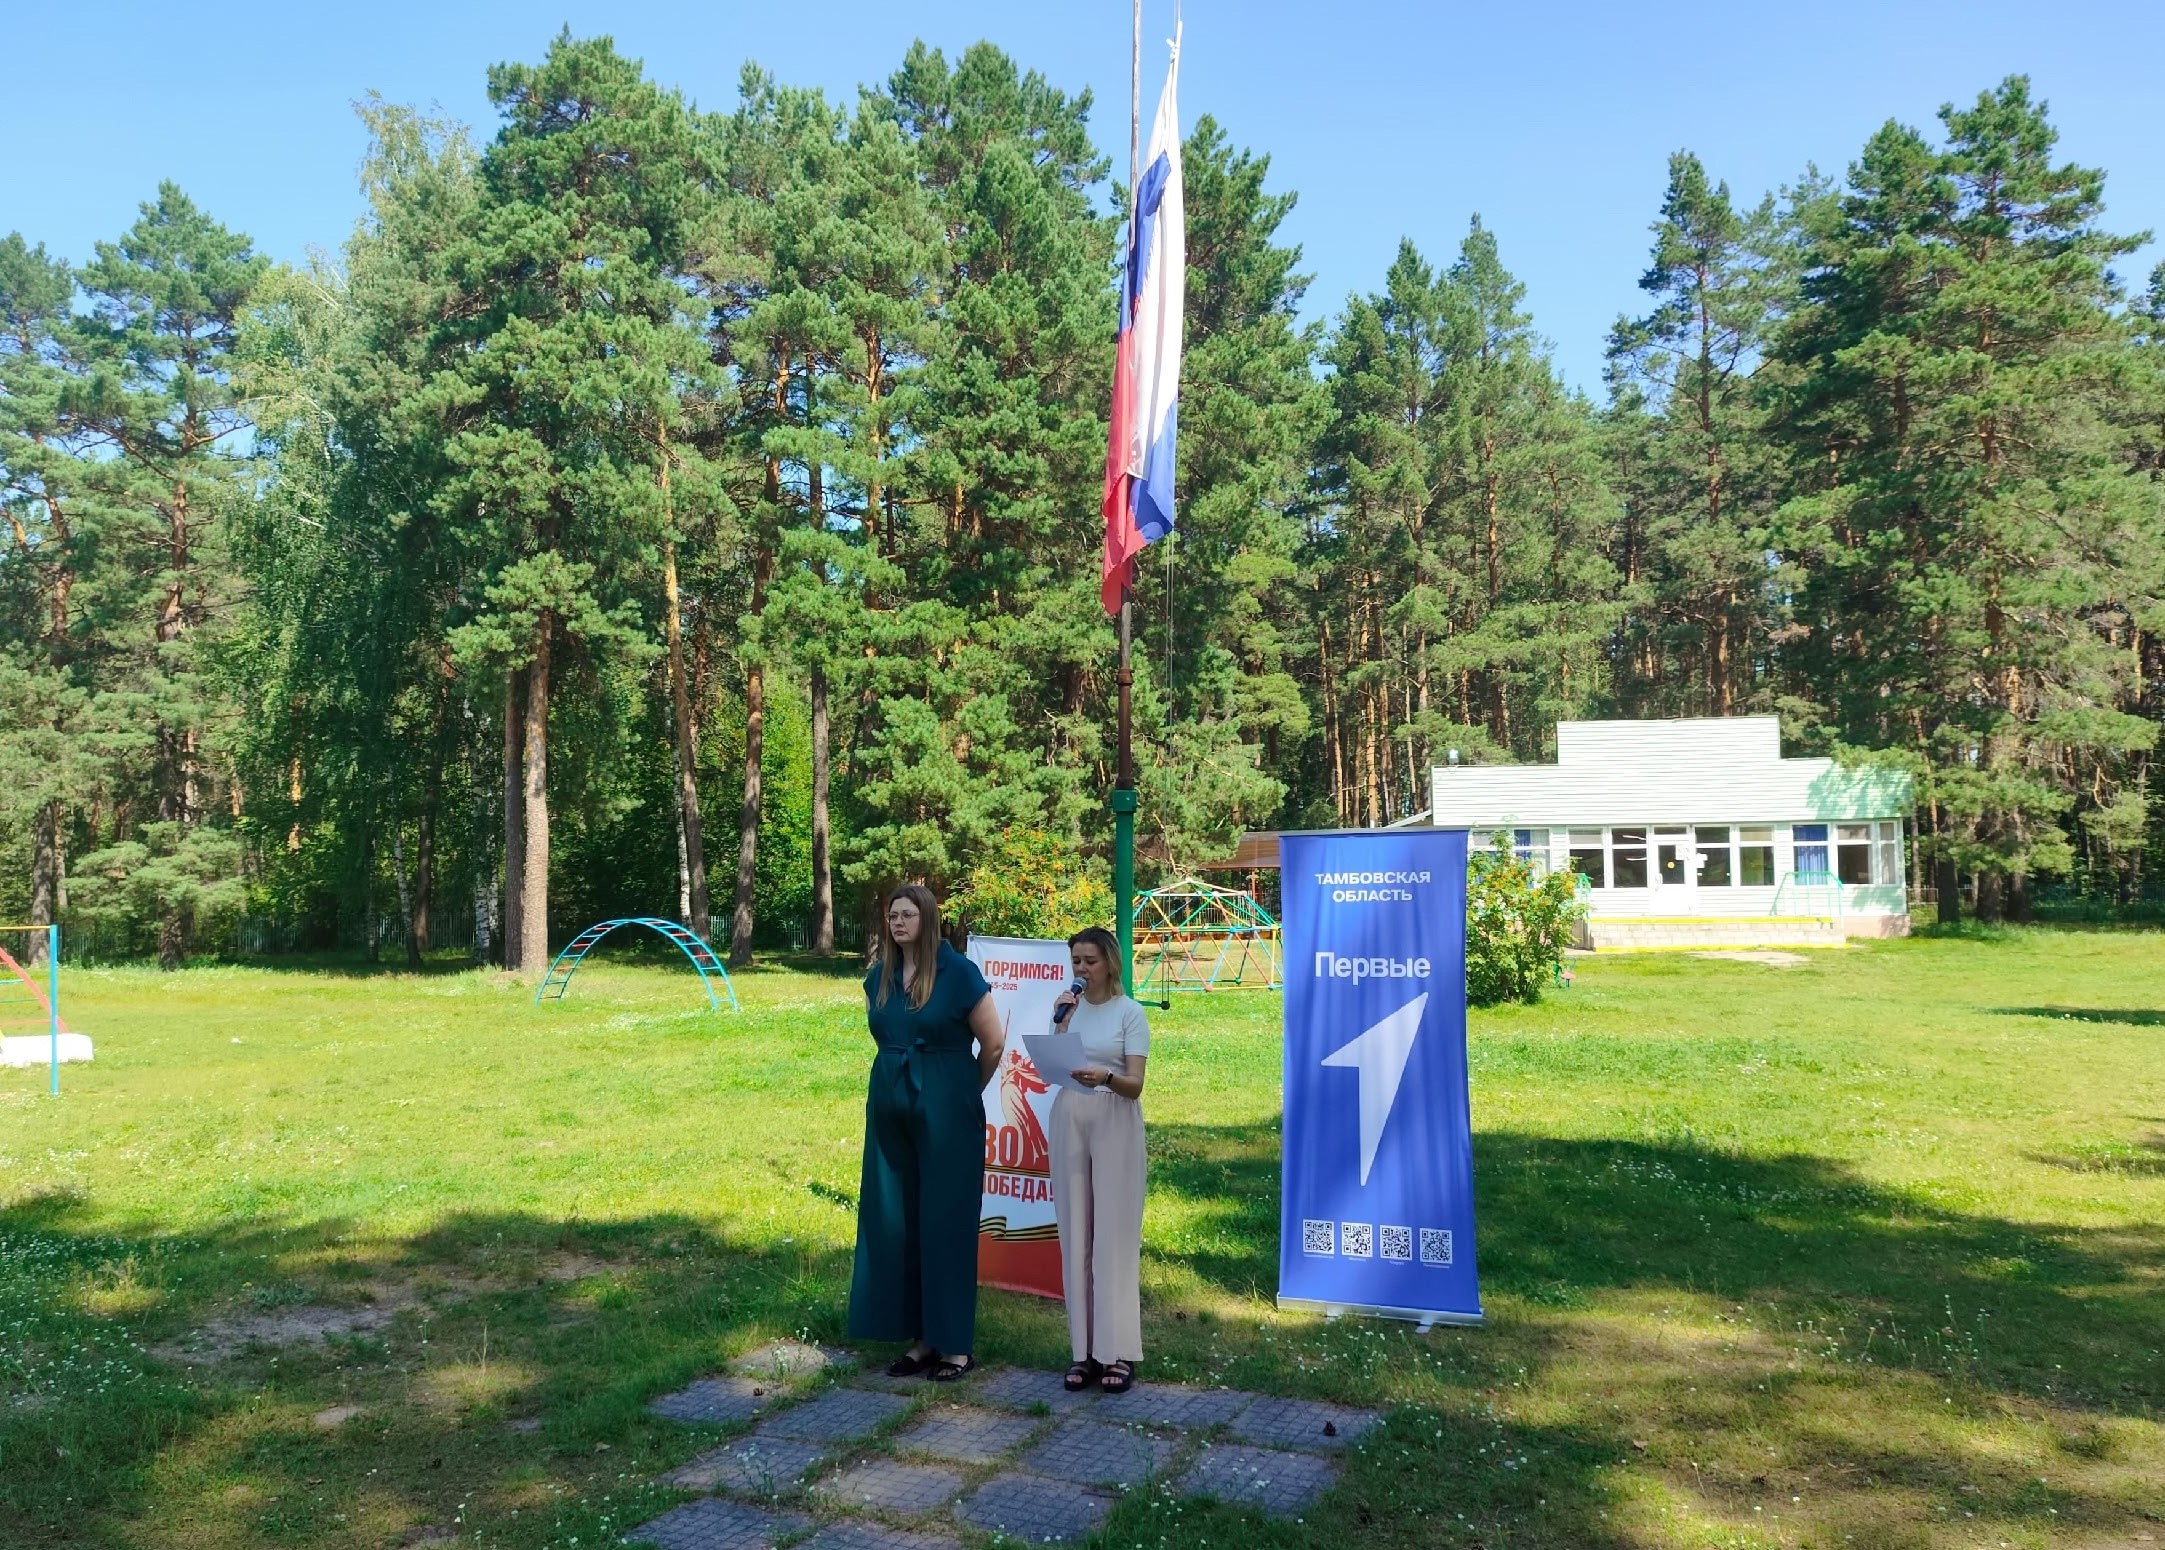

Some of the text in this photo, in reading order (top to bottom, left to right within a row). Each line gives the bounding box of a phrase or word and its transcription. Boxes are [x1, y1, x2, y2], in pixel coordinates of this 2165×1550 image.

[1315, 871, 1431, 885] ТАМБОВСКАЯ
[1332, 889, 1413, 903] ОБЛАСТЬ
[984, 960, 1064, 981] ГОРДИМСЯ!
[1315, 951, 1431, 986] Первые
[983, 1173, 1054, 1203] ОБЕДА!
